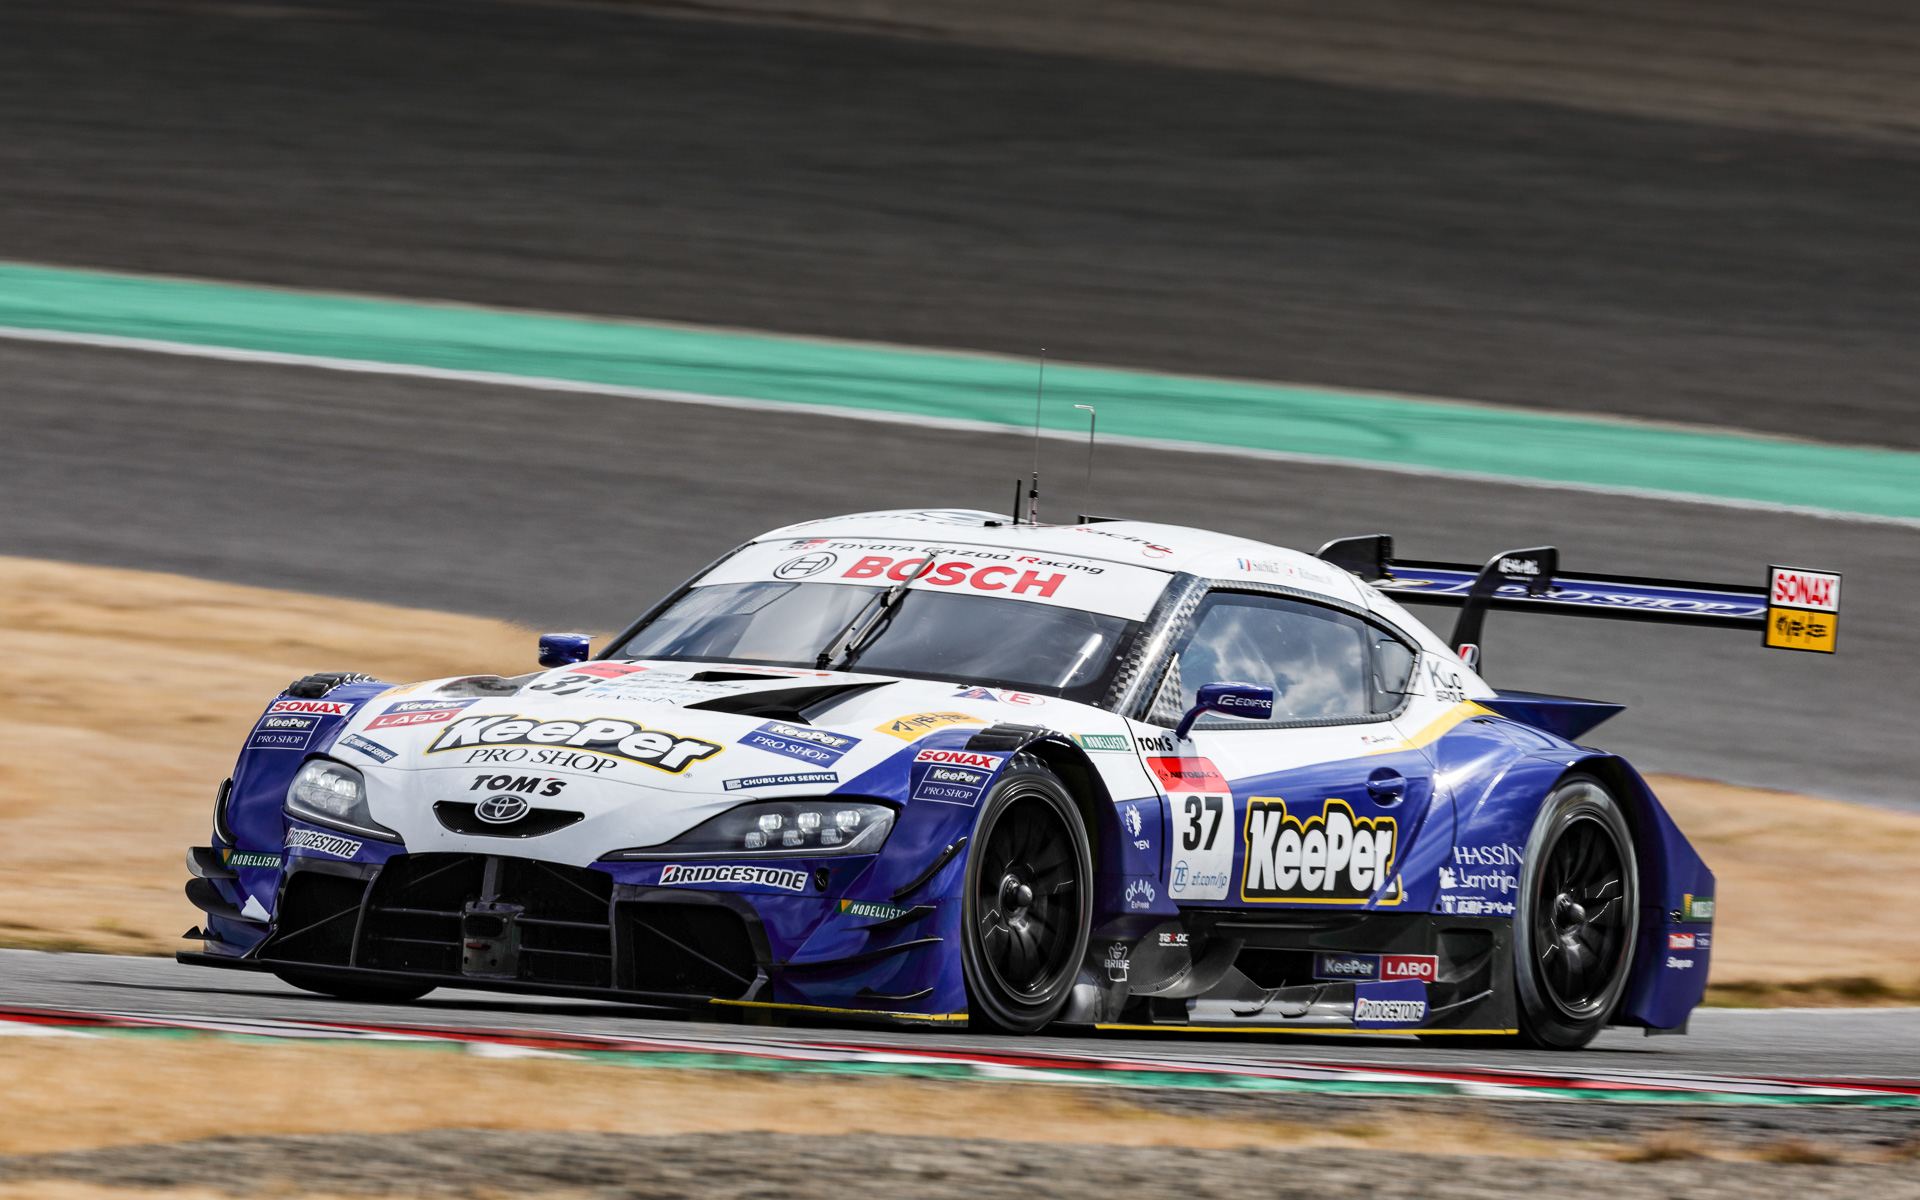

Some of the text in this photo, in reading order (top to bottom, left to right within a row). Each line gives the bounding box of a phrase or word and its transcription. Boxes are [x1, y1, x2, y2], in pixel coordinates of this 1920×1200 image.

[827, 542, 1105, 575] TOYOTA GAZOO Racing
[841, 555, 1066, 599] BOSCH
[1773, 573, 1834, 607] SONAX
[1604, 594, 1737, 616] SHOP
[271, 701, 346, 714] SONAX
[395, 700, 462, 713] KeePer
[265, 717, 312, 730] KeePer
[376, 711, 450, 727] LABO
[256, 735, 304, 744] PRO SHOP
[430, 714, 720, 772] KeePer
[770, 724, 848, 747] KeePer
[1137, 735, 1174, 752] TOM'S
[752, 735, 830, 761] PRO SHOP
[465, 748, 618, 774] PRO SHOP
[917, 750, 996, 769] SONAX
[742, 773, 836, 787] CHUBU CAR SERVICE
[932, 769, 981, 784] KeePer
[1169, 770, 1219, 779] AUTOBACS
[469, 774, 567, 797] TOM'S
[923, 786, 973, 799] PRO SHOP
[1182, 795, 1224, 851] 37
[285, 828, 363, 858] BRIDGESTONE
[1246, 806, 1398, 895] KeePer
[231, 853, 281, 868] MODELLISTA
[660, 865, 808, 890] BRIDGESTONE
[1191, 871, 1228, 888] zf.com/jp
[1125, 878, 1156, 902] OKANO
[1104, 958, 1130, 970] BRIDE
[1323, 958, 1432, 977] KeePer LABO
[1356, 997, 1426, 1023] BRIDGESTONE
